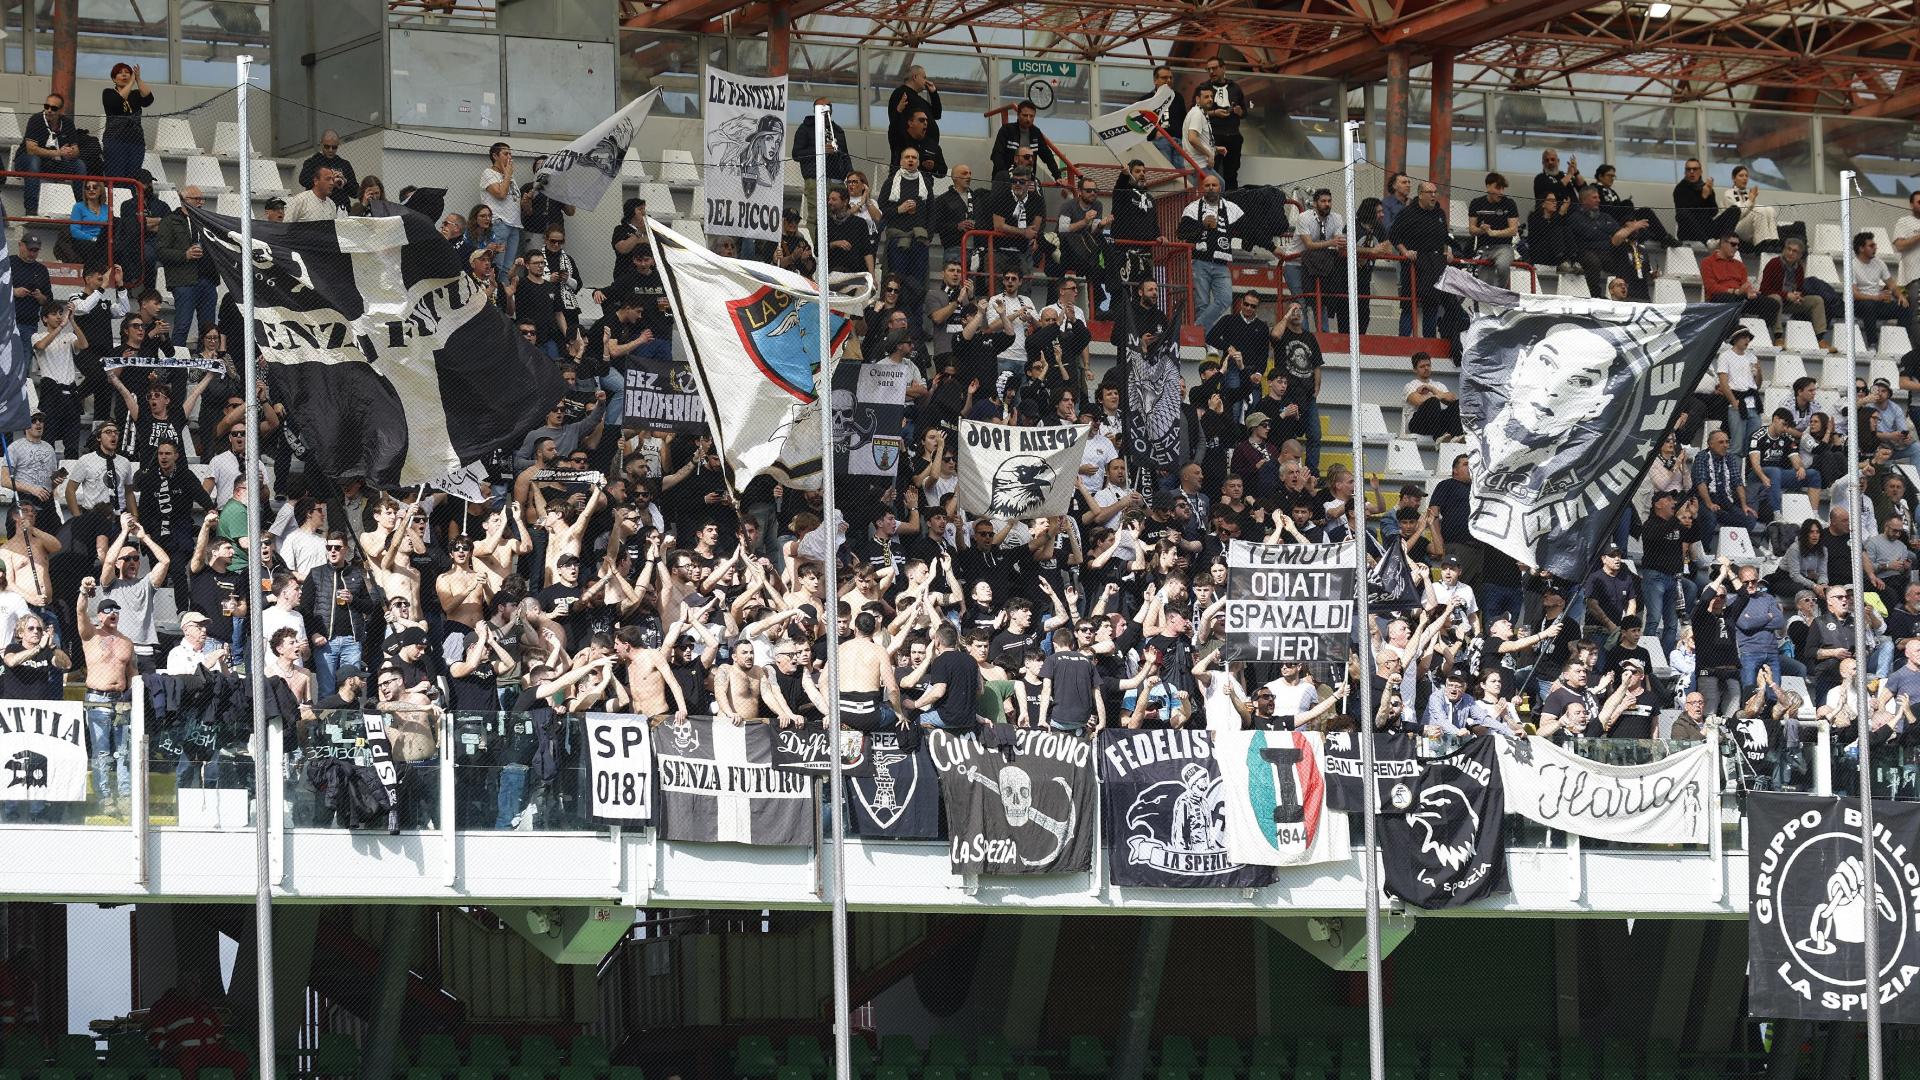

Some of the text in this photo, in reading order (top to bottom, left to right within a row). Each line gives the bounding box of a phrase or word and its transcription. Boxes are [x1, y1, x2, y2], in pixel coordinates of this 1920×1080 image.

[1018, 62, 1053, 73] USCITA
[708, 75, 786, 111] LE FANTELE
[1103, 126, 1128, 140] 1944
[738, 201, 780, 233] PICCO
[745, 300, 776, 329] LA
[626, 368, 662, 390] SEZ.
[1249, 544, 1343, 565] TEMUTI
[1251, 572, 1331, 598] ODIATI
[1229, 604, 1350, 630] SPAVALDI
[1256, 636, 1319, 661] FIERI
[594, 725, 643, 759] SP
[929, 729, 1089, 772] Curv errovia
[1105, 730, 1217, 777] FEDELIS
[662, 758, 805, 794] SENZA FUTURO
[1326, 757, 1414, 777] SAN TRENZO
[596, 769, 648, 807] 0187
[1538, 763, 1683, 820] Ilaria
[1276, 828, 1308, 845] 1944
[1163, 851, 1180, 869] LA
[1756, 809, 1823, 925] GRUPPO
[1777, 961, 1920, 1012] LA SPZIA
